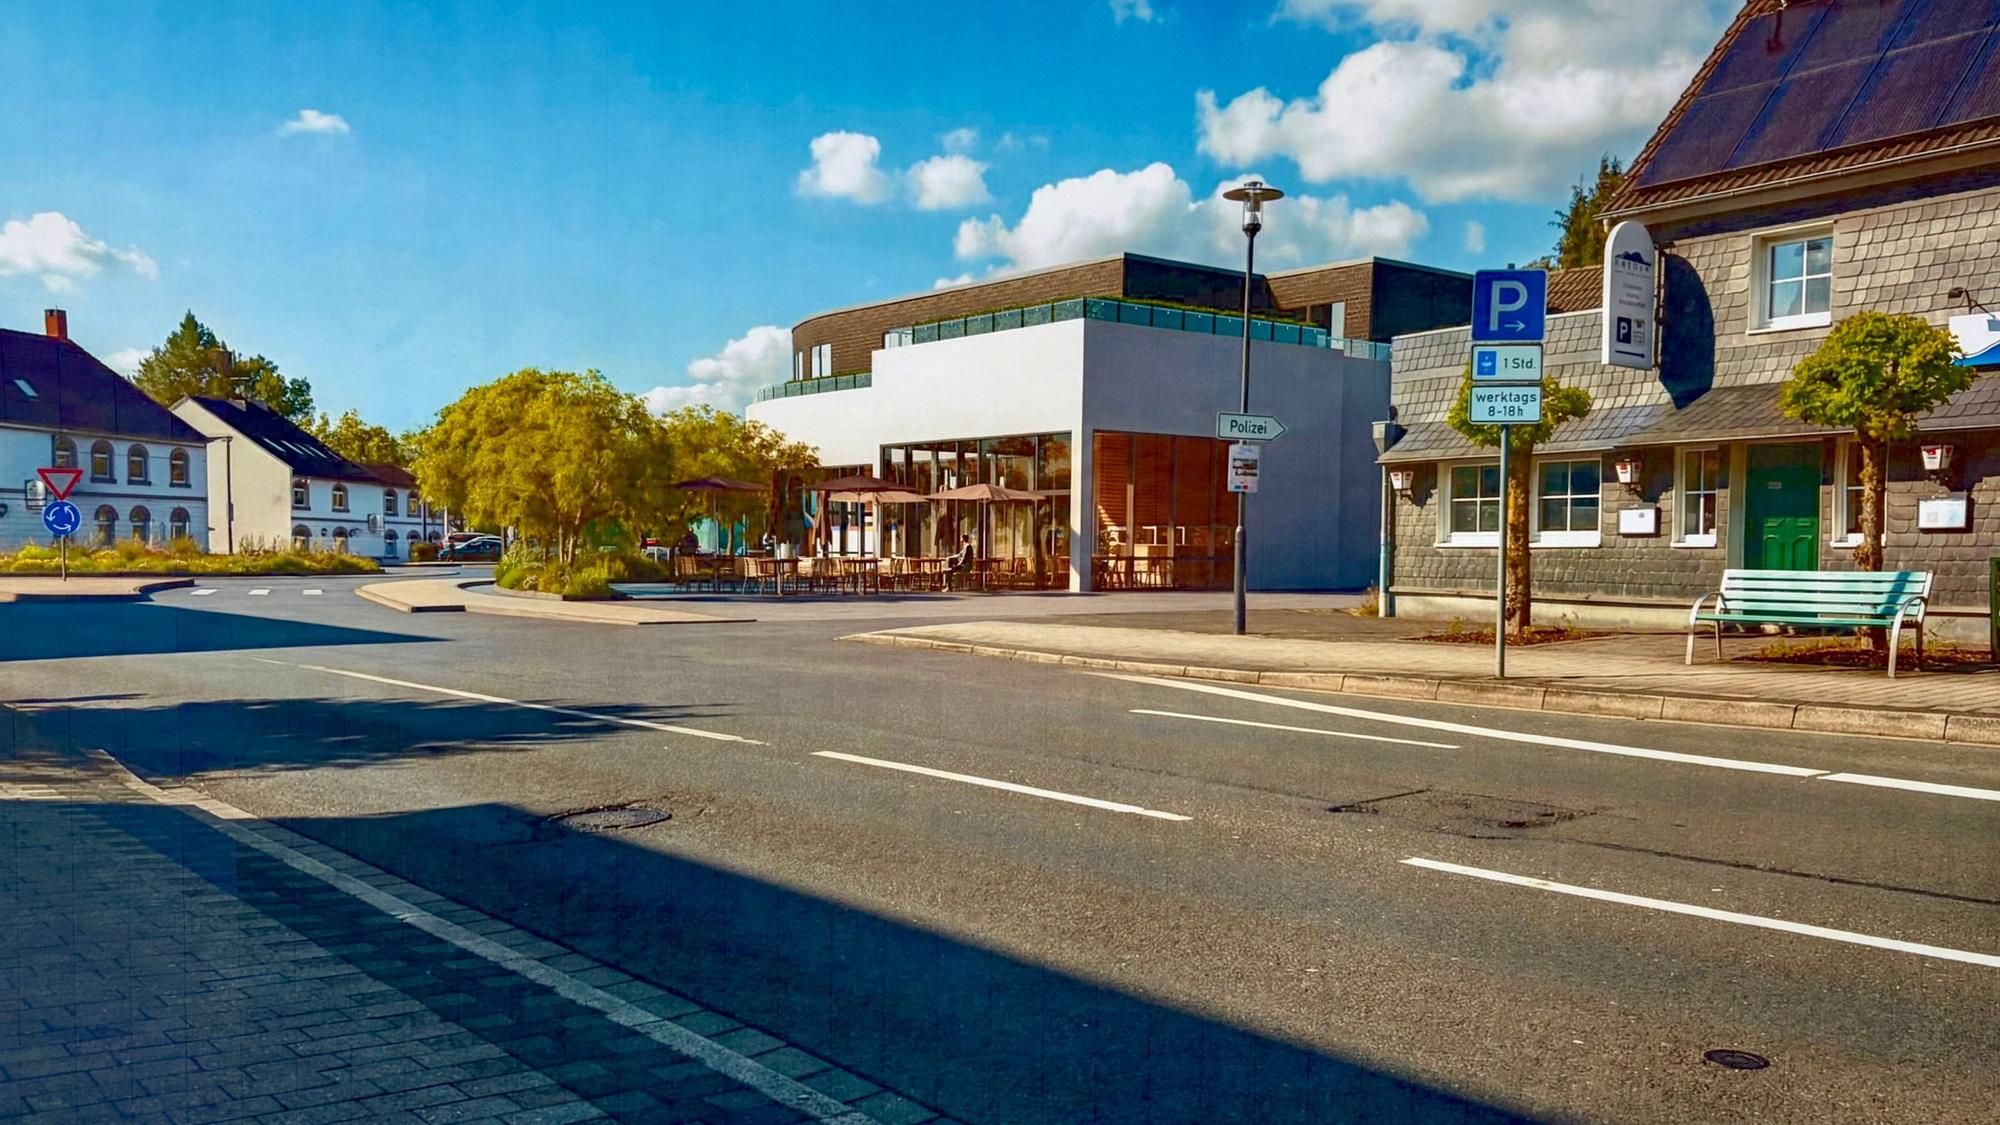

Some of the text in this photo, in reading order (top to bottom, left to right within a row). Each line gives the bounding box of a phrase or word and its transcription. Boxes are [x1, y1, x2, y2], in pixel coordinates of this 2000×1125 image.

[1489, 280, 1528, 331] P
[1620, 321, 1628, 340] P
[1503, 358, 1536, 369] 1 Std.
[1475, 392, 1537, 405] werktags
[1230, 419, 1267, 435] Polizei
